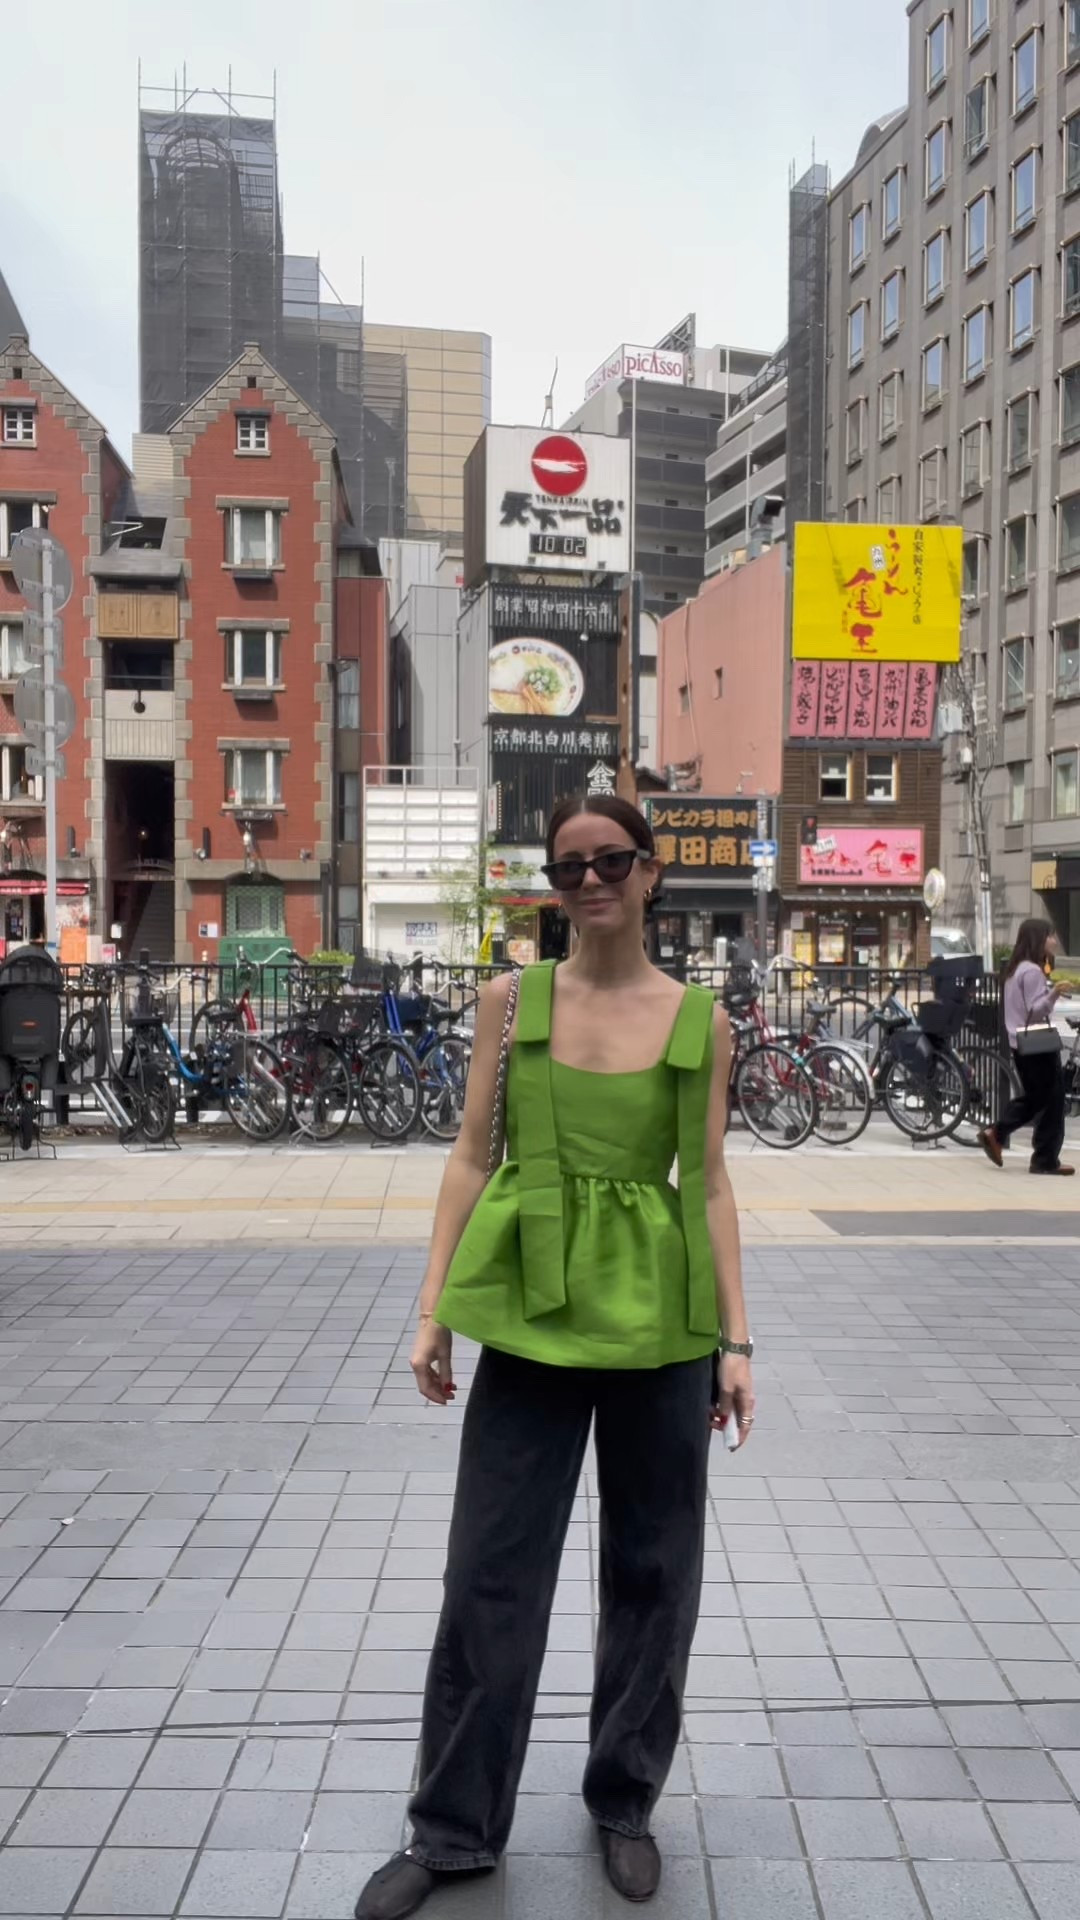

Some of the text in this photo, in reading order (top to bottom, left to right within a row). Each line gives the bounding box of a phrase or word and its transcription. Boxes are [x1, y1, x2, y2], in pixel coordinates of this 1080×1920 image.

[499, 490, 623, 537] 天下一品
[538, 536, 586, 554] 10 02
[494, 728, 609, 749] 京都北白川発祥
